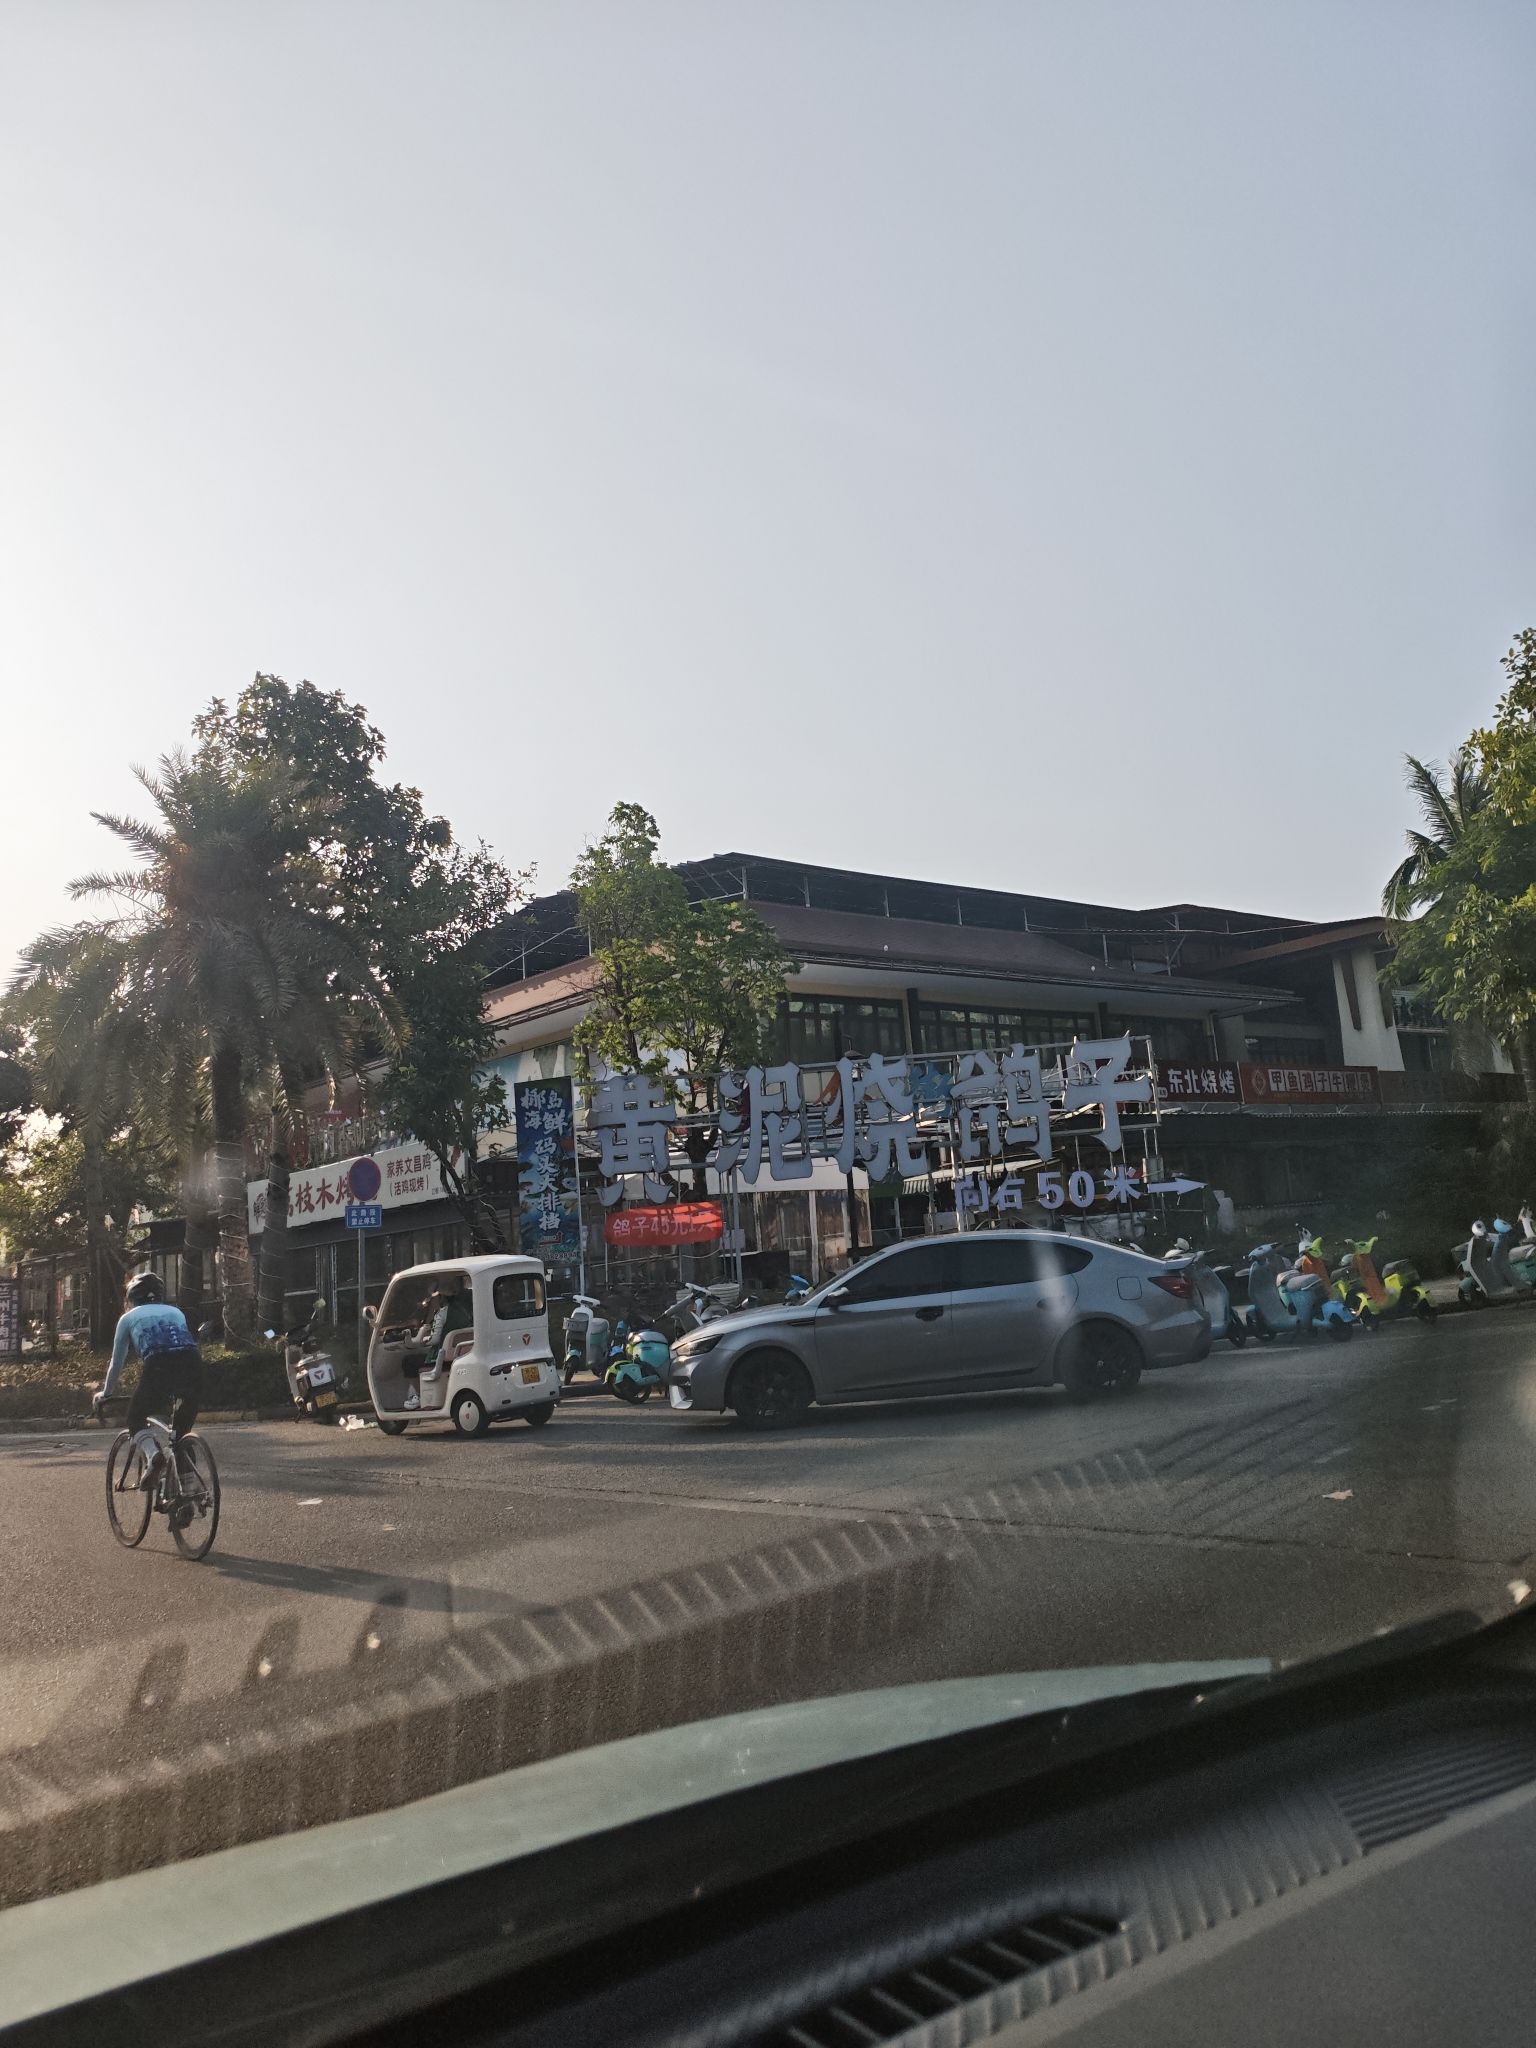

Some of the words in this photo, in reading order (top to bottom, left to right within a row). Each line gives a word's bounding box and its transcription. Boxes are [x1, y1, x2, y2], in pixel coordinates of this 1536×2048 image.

[1168, 1067, 1236, 1095] 东北烧烤
[584, 1031, 1153, 1207] 黄泥烧鸽子
[386, 1153, 432, 1178] 家养文昌鸡
[953, 1164, 1141, 1213] 向右50米
